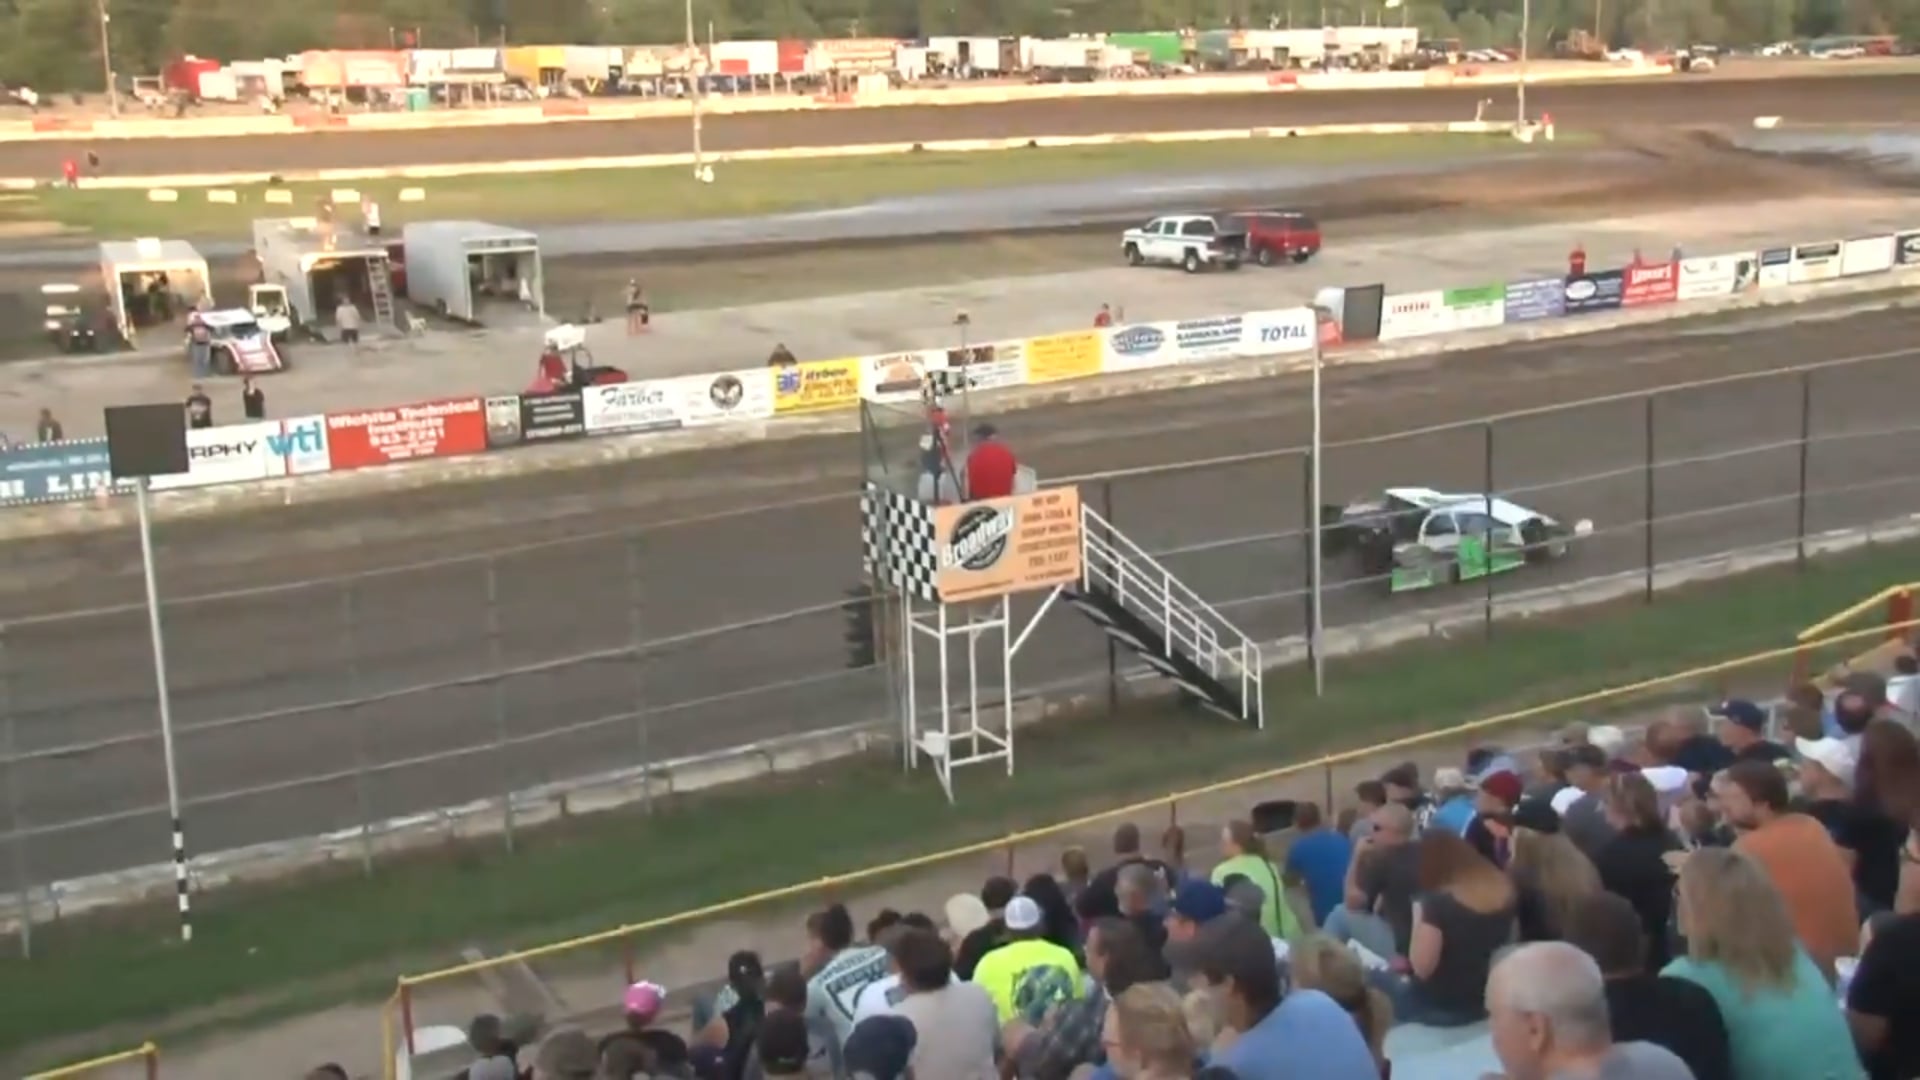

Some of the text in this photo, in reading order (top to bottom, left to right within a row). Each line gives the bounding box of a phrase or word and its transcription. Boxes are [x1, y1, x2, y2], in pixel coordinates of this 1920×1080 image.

[1260, 325, 1308, 343] TOTAL
[328, 410, 397, 429] Wichita
[398, 398, 480, 420] Technical
[600, 387, 665, 415] Farber
[940, 504, 1014, 569] Broadway
